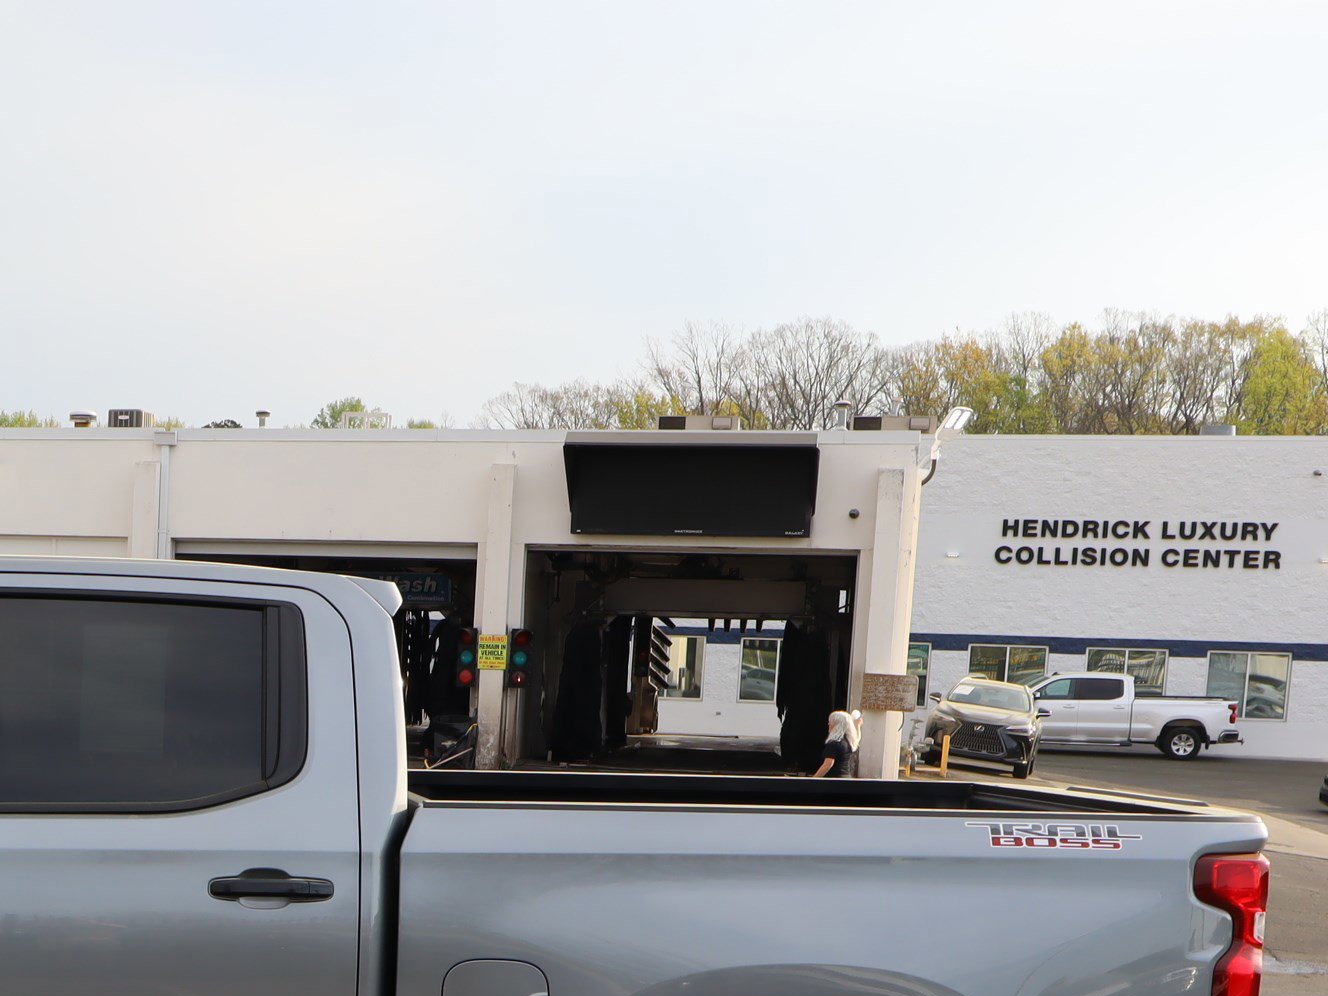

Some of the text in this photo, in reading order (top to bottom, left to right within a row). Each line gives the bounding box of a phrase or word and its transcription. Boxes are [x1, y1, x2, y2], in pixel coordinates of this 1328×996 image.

[1001, 519, 1279, 541] HENDRICK LUXURY
[994, 545, 1282, 569] COLLISION CENTER
[965, 822, 1143, 840] TRAIL
[990, 836, 1123, 850] BOSS
